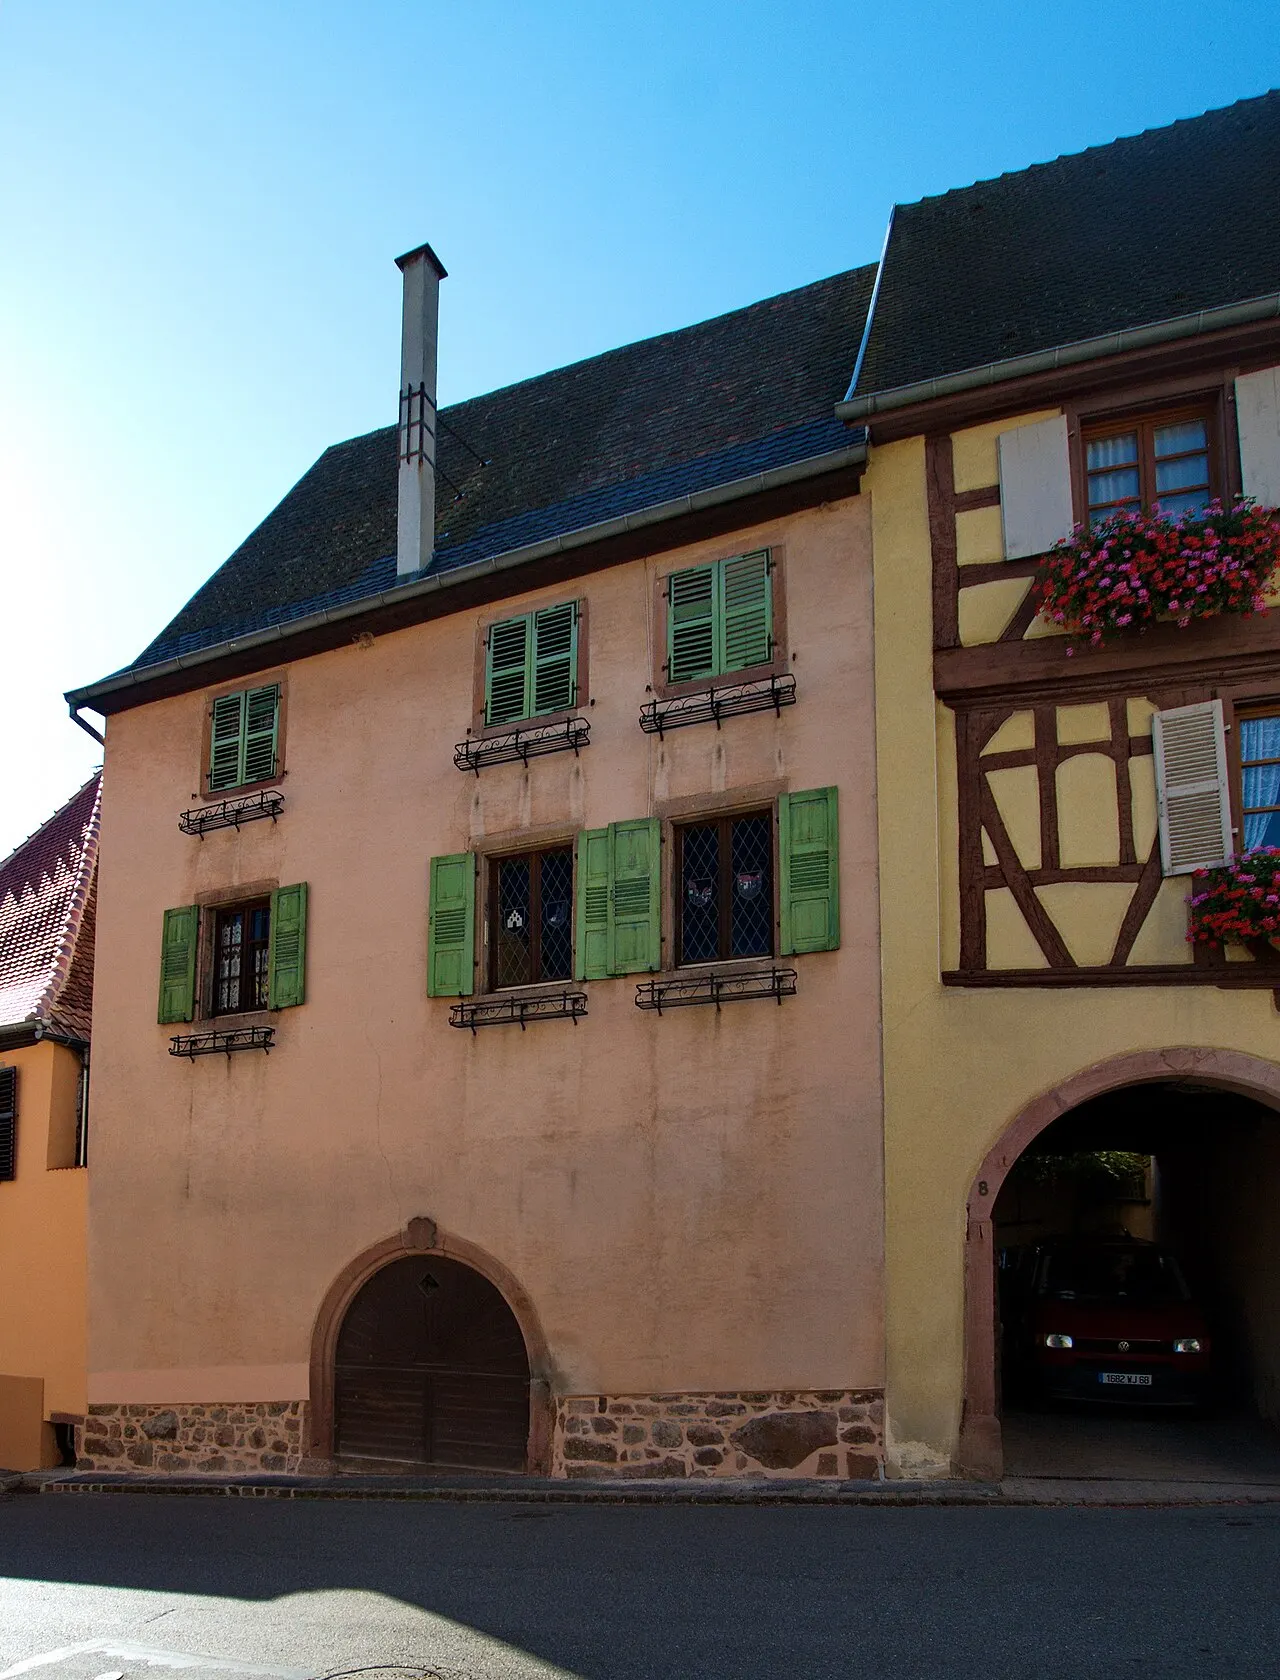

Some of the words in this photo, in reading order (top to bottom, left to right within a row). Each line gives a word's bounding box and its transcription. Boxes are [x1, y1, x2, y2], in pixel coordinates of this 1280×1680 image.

[979, 1181, 988, 1196] 8
[1106, 1374, 1125, 1383] 1682
[1139, 1375, 1149, 1385] 68
